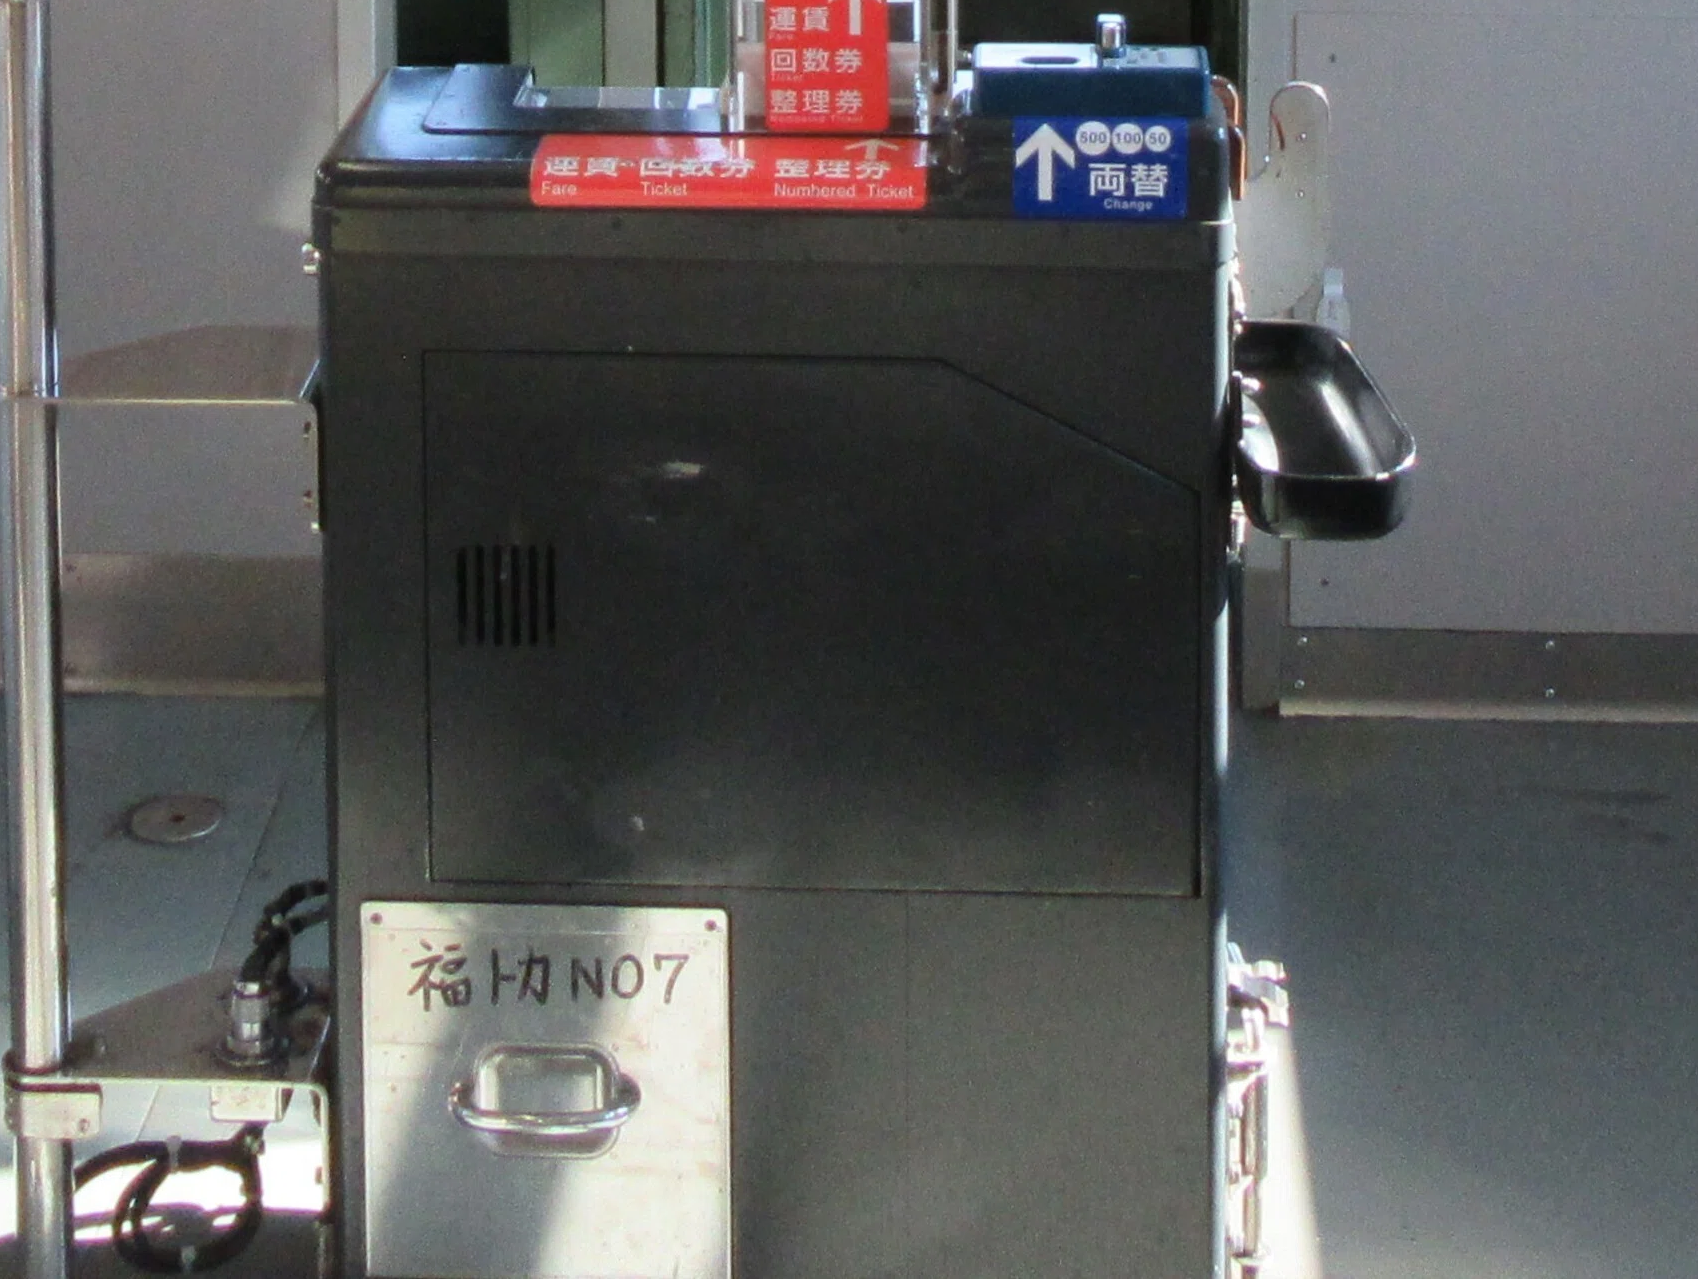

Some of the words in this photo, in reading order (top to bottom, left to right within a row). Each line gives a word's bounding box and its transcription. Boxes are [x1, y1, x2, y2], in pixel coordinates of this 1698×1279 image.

[769, 6, 830, 32] 運賃
[770, 47, 863, 74] 回数券
[770, 89, 863, 114] 整理券
[1079, 131, 1107, 144] 500
[1114, 132, 1141, 144] 100
[1149, 132, 1167, 144] 50
[543, 155, 619, 178] 運賃
[638, 156, 756, 180] 回数券
[774, 157, 891, 180] 整理券
[541, 181, 577, 196] Fare
[640, 181, 688, 197] Ticket
[866, 184, 914, 199] Ticket
[1088, 163, 1168, 198] 両替
[1103, 198, 1153, 211] Change
